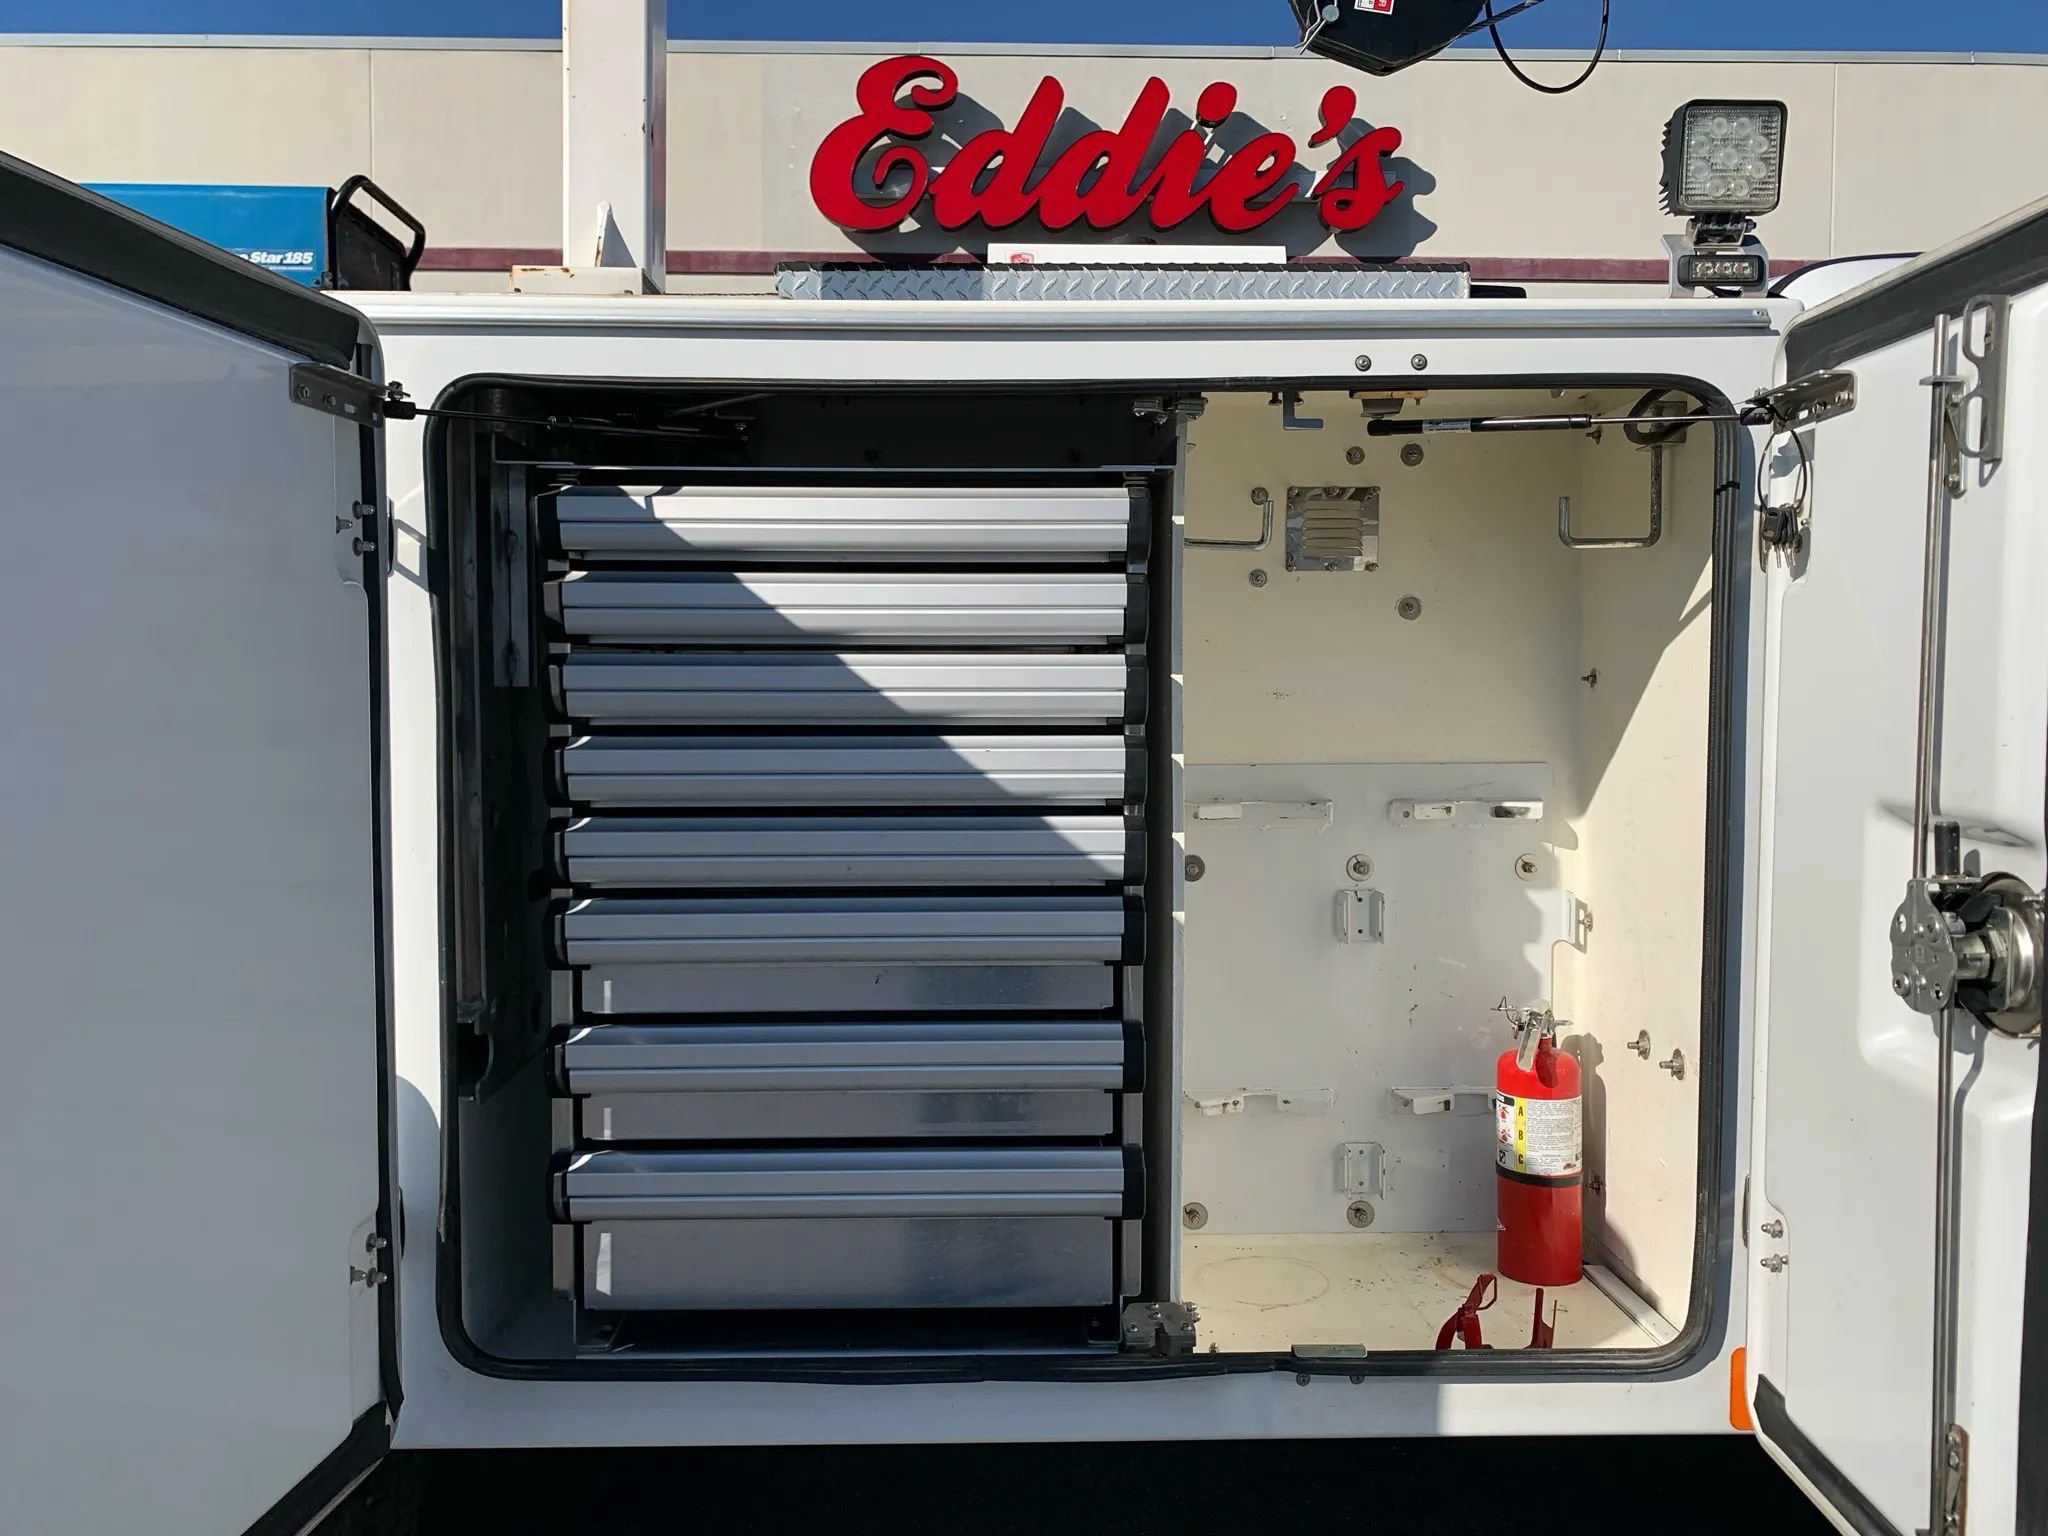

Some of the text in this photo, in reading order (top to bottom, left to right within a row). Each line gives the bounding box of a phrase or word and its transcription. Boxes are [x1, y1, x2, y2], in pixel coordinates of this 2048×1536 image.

[810, 56, 1404, 230] Eddie's
[1518, 1106, 1524, 1117] A
[1518, 1130, 1524, 1140] B
[1518, 1153, 1524, 1165] C
